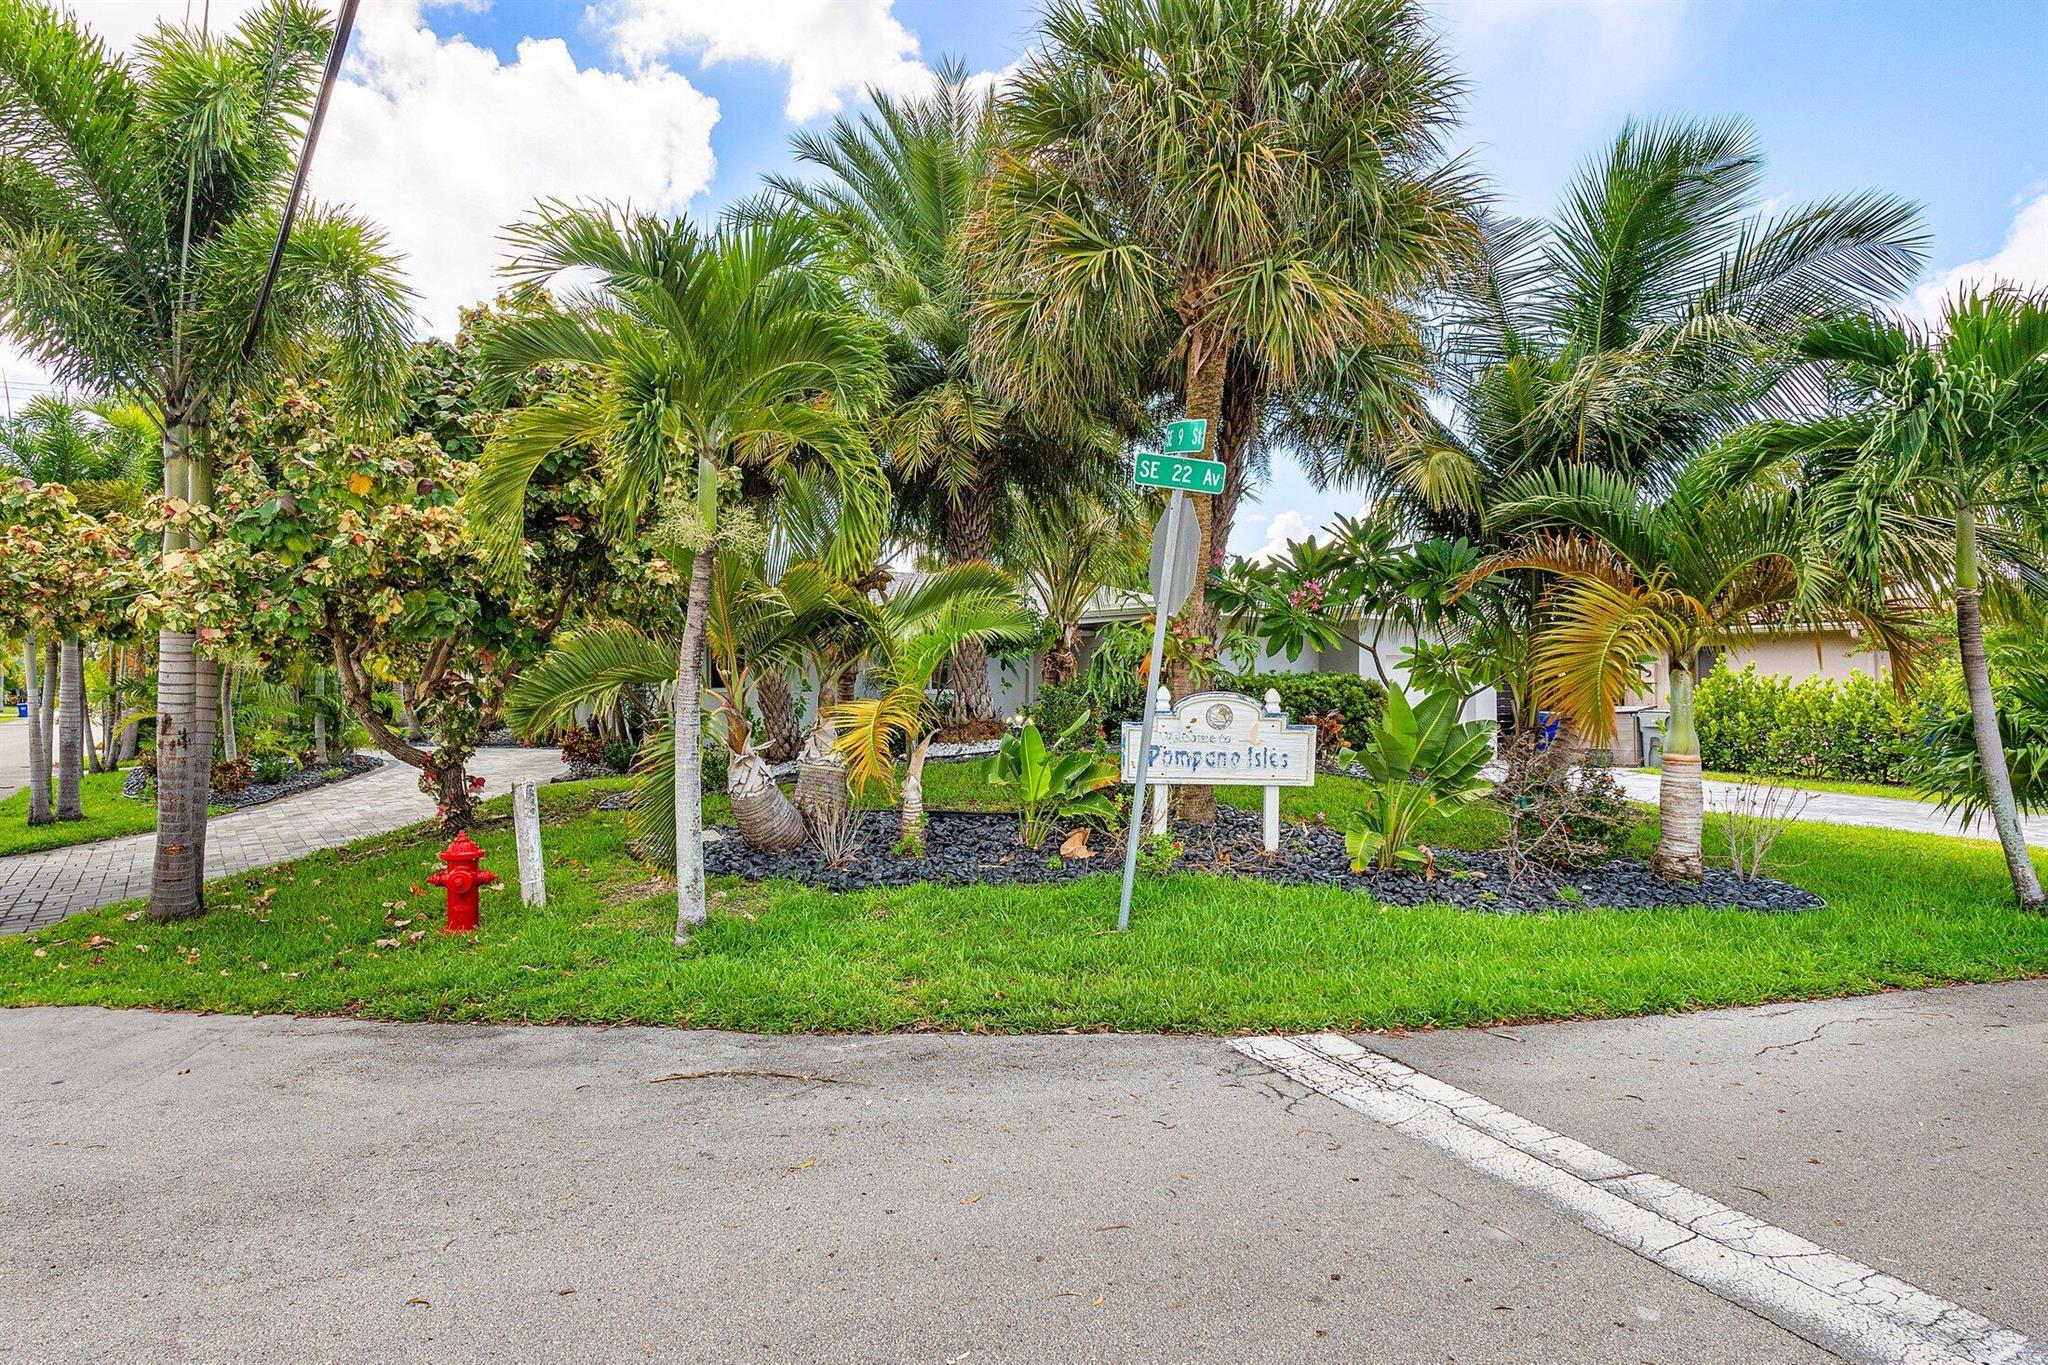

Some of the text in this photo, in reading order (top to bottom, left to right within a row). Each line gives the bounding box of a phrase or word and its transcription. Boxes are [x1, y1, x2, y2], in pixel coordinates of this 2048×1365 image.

[1178, 428, 1184, 446] 9
[1191, 427, 1202, 445] St
[1139, 460, 1160, 479] SE
[1171, 464, 1193, 483] 22
[1217, 733, 1232, 744] to
[1148, 744, 1289, 772] Pompano Isles
